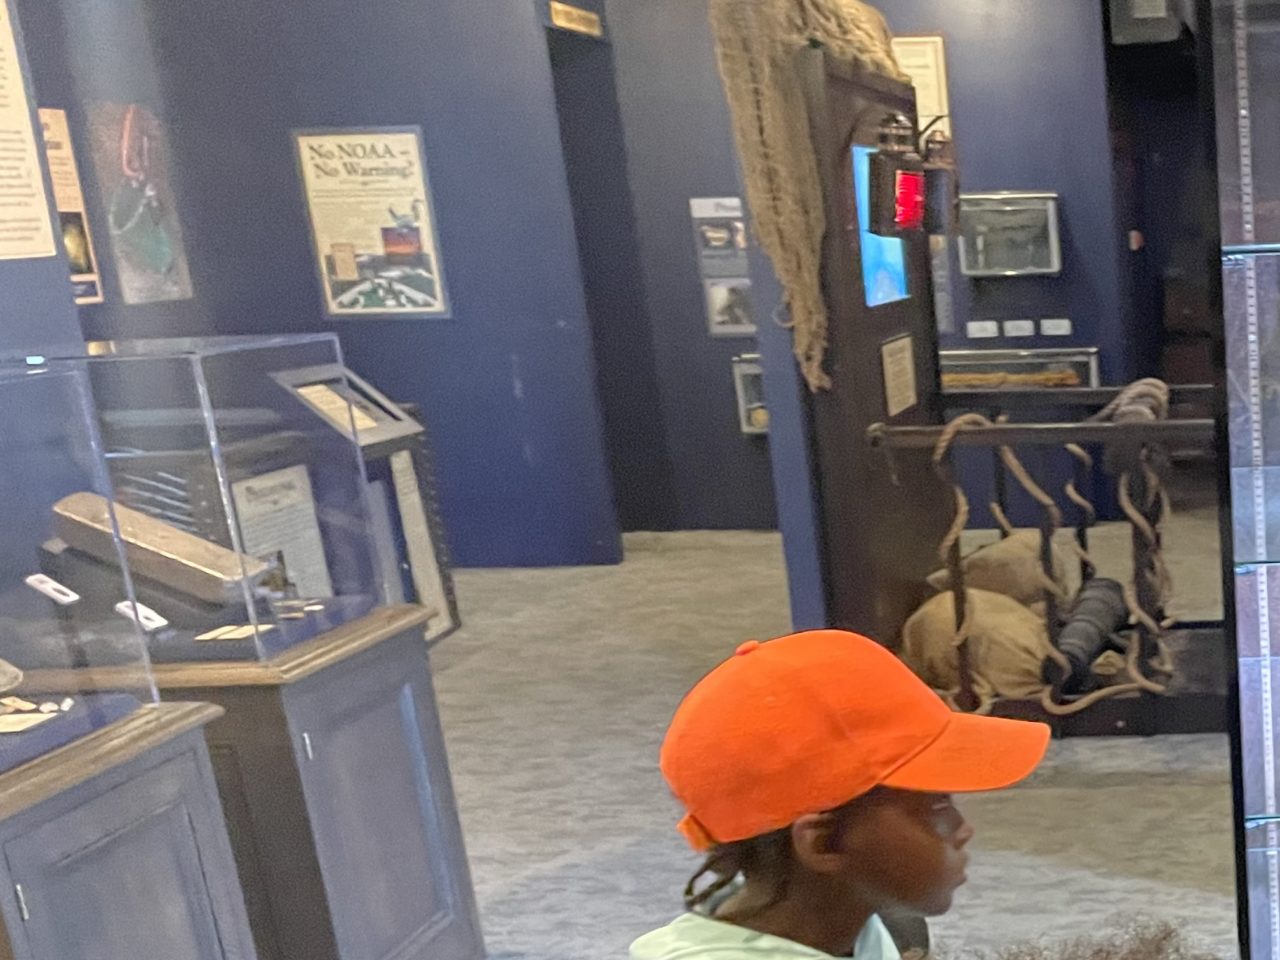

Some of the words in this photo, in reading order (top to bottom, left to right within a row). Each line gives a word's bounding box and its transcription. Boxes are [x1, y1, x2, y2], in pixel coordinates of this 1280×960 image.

[308, 143, 335, 160] No
[337, 143, 396, 159] NOAA
[314, 162, 340, 179] No
